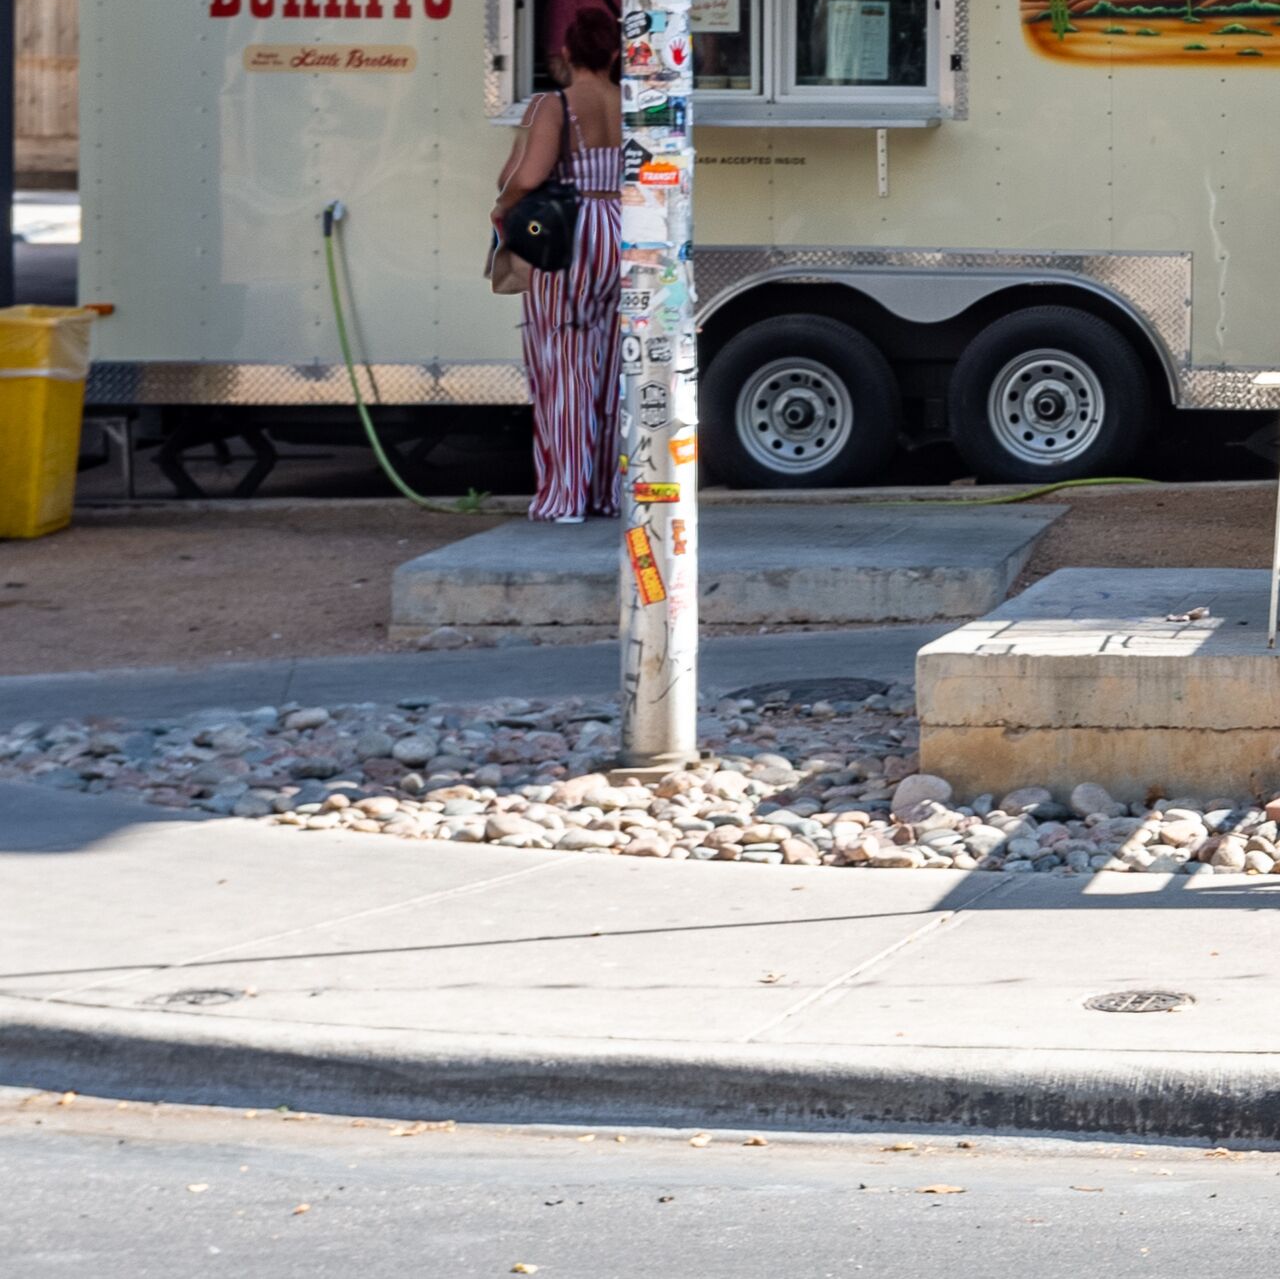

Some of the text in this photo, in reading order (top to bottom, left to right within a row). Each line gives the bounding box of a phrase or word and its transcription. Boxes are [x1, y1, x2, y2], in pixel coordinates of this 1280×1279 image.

[290, 49, 340, 68] Little
[345, 48, 409, 69] Brother
[719, 156, 772, 165] ACCEPTED
